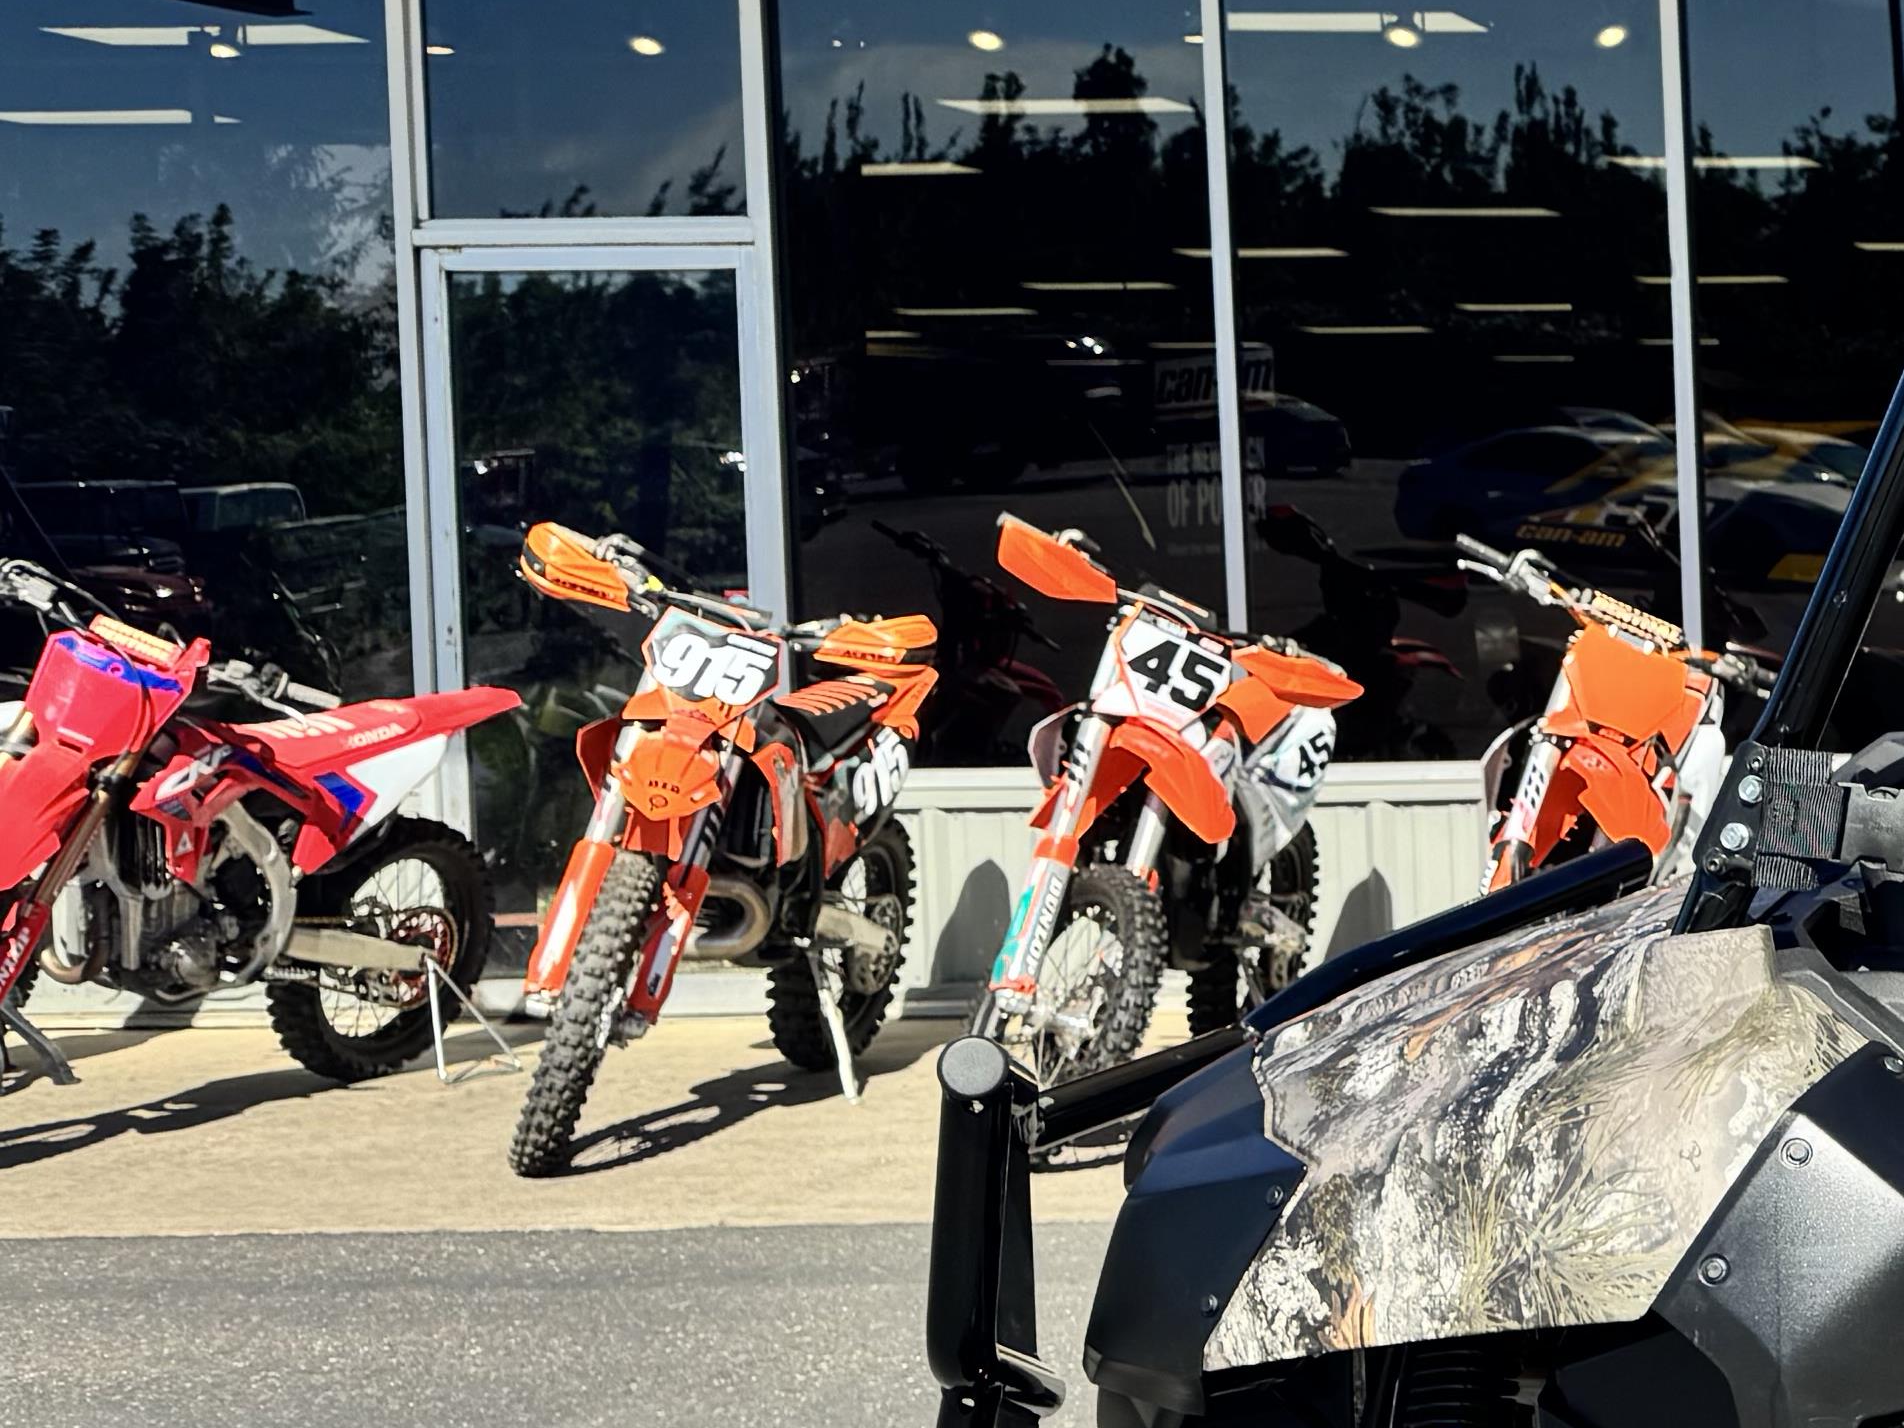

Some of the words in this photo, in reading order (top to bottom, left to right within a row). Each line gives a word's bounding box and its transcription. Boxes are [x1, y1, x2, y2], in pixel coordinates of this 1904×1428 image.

[1156, 359, 1272, 403] canm
[1196, 471, 1267, 527] POER
[652, 632, 774, 706] 915
[1127, 639, 1225, 712] 45
[1298, 731, 1333, 779] 45
[1024, 874, 1064, 975] DUNLOP
